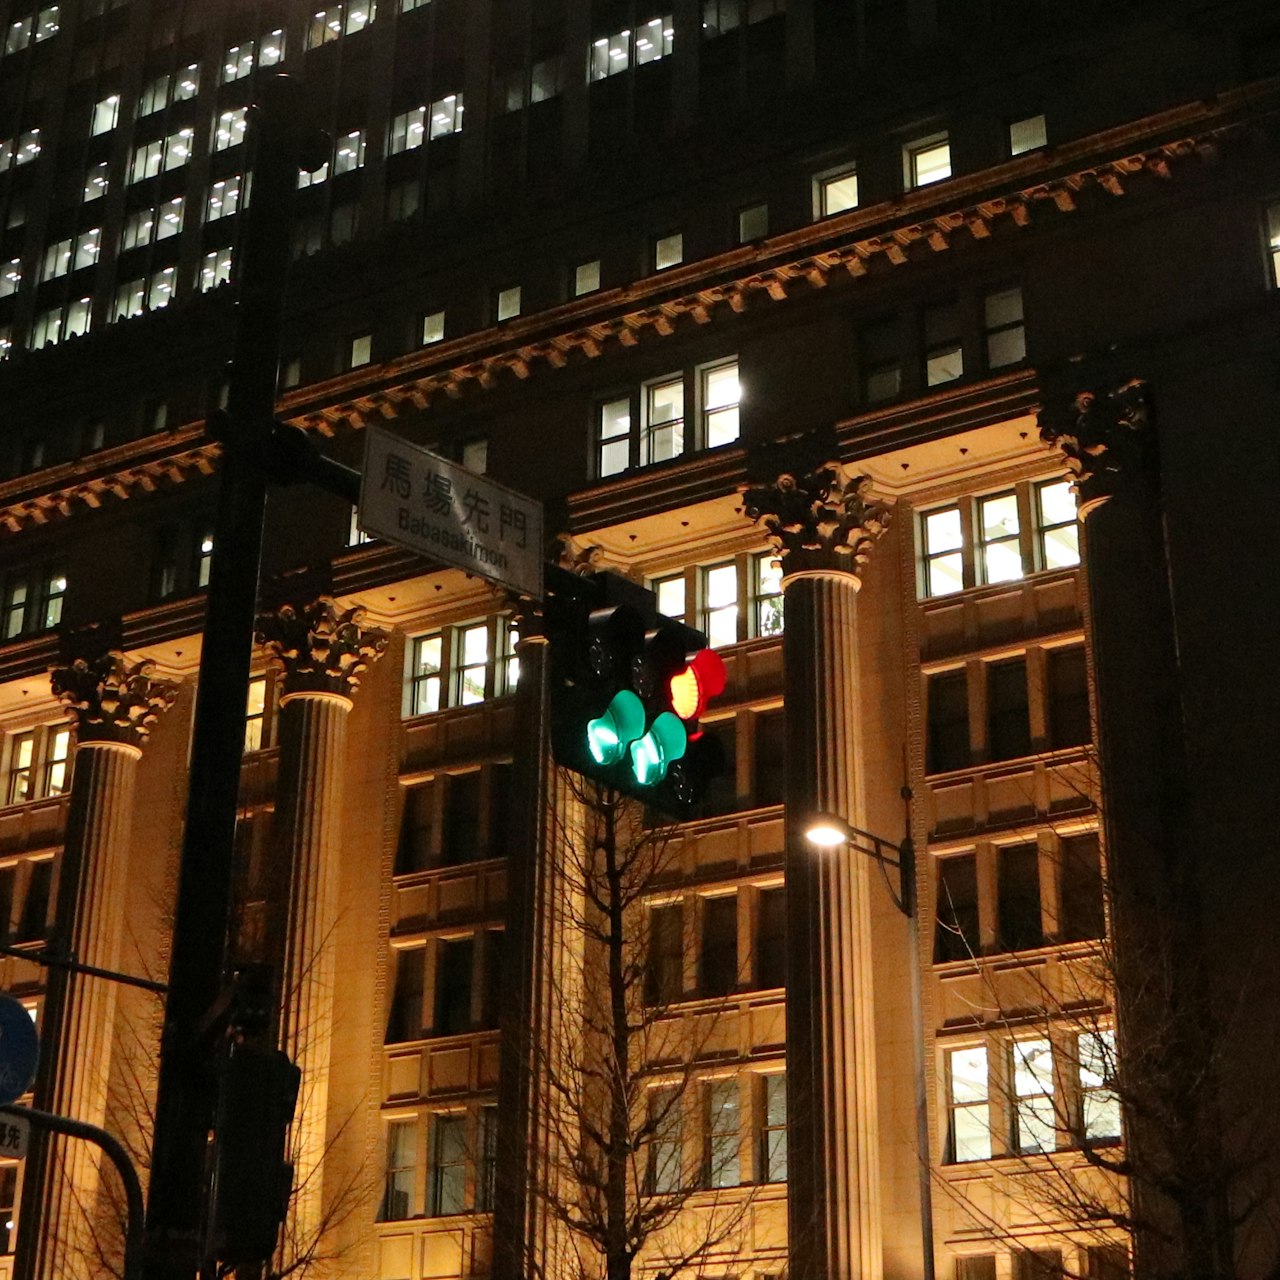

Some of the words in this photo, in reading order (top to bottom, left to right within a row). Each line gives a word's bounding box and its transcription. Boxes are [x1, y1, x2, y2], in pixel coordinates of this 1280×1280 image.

[381, 454, 527, 549] 馬場先門
[398, 508, 507, 569] Babasakimon
